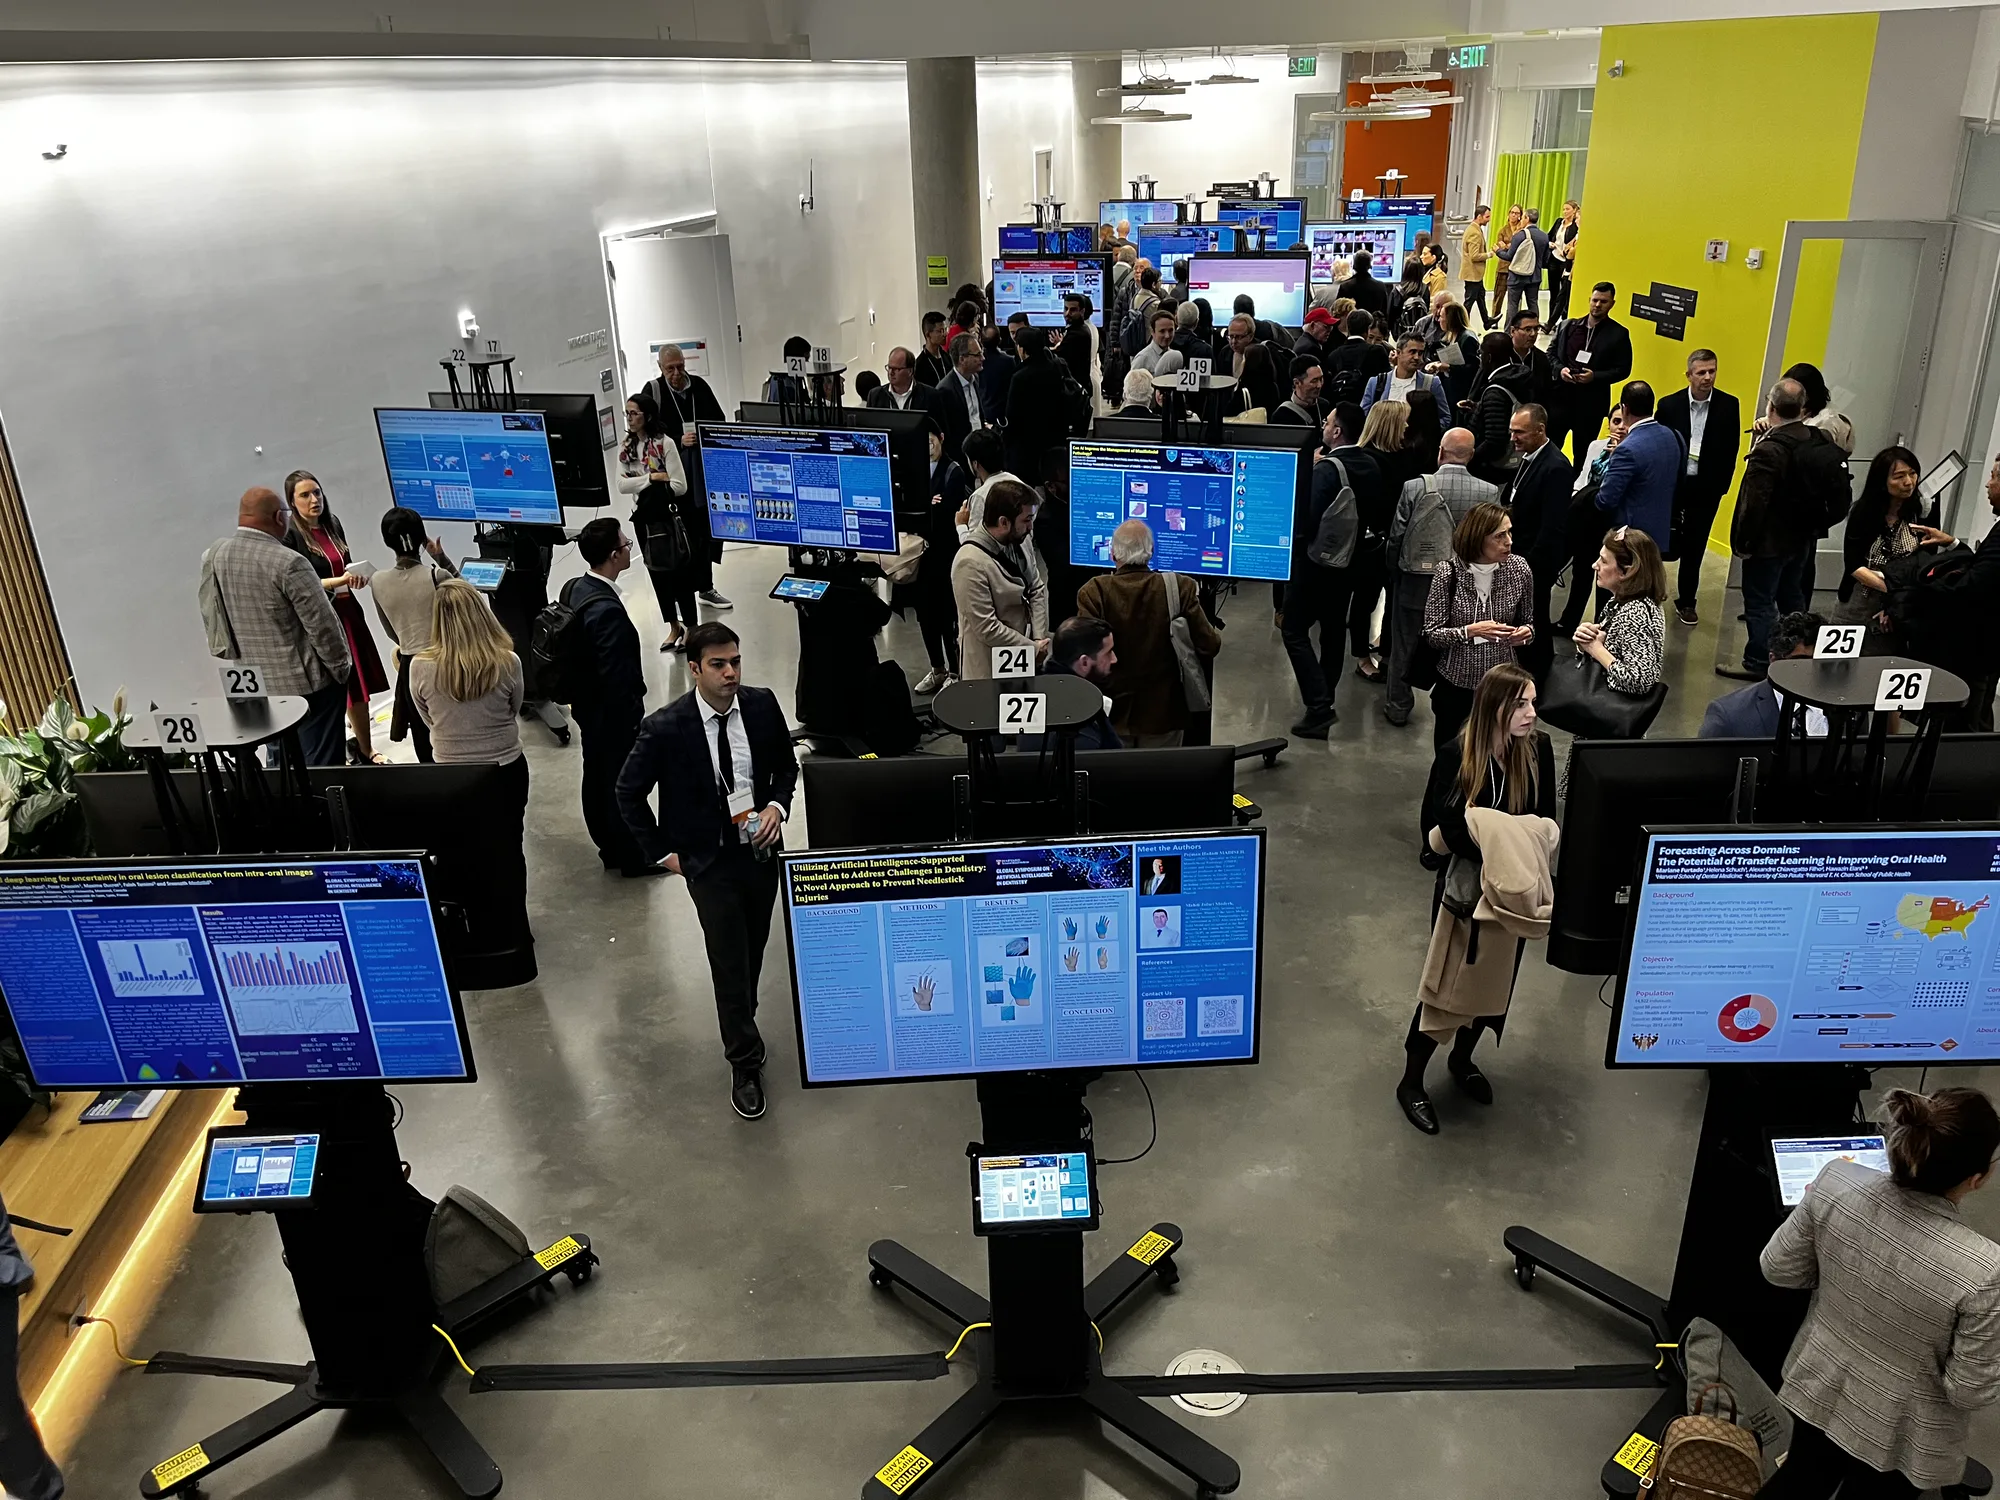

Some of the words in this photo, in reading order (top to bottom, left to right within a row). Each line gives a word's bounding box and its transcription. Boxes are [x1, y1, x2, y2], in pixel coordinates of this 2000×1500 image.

[1298, 57, 1315, 72] EXIT
[1460, 45, 1486, 68] EXIT
[452, 350, 465, 361] 22
[487, 341, 497, 352] 17
[816, 349, 827, 361] 18
[791, 359, 802, 371] 21
[1194, 360, 1207, 373] 19
[1181, 372, 1196, 385] 20
[1822, 629, 1856, 654] 25
[999, 649, 1028, 673] 24
[227, 669, 259, 693] 23
[1885, 673, 1921, 700] 26
[1006, 698, 1038, 723] 27
[163, 717, 197, 743] 28
[1660, 846, 1717, 857] Forecasting
[1718, 846, 1751, 854] Across
[1752, 845, 1800, 854] Domains:
[1678, 856, 1723, 865] Potential
[1725, 856, 1735, 865] of
[1736, 856, 1779, 865] Transfer
[1780, 856, 1824, 866] Learning
[1826, 856, 1836, 864] in
[1838, 855, 1889, 866] Improving
[1890, 855, 1912, 864] Oral
[1913, 854, 1947, 864] Health
[792, 862, 829, 872] Utilizing
[830, 861, 868, 870] Artificial
[870, 855, 964, 868] Intelligence-Supported
[793, 872, 838, 882] Simulation
[851, 870, 885, 879] Address
[886, 868, 932, 877] Challenges
[934, 866, 943, 874] in
[944, 864, 987, 874] Dentistry:
[4, 876, 23, 884] deep
[25, 876, 58, 884] learning
[72, 874, 117, 883] uncertainty
[145, 872, 169, 880] lesion
[171, 870, 222, 879] classification
[224, 870, 243, 878] from
[284, 868, 314, 877] images
[803, 883, 827, 891] Novel
[829, 881, 871, 891] Approach
[872, 880, 881, 888] to
[883, 878, 915, 887] Prevent
[916, 876, 964, 885] Needlestick
[795, 894, 829, 903] Injuries
[807, 908, 859, 917] BACKGROUND
[1063, 1008, 1113, 1016] CONCLUSION
[544, 1246, 578, 1268] CAUTION
[1142, 1240, 1169, 1264] CAUTION
[1620, 1437, 1640, 1459] HAZARD
[1626, 1441, 1649, 1466] TRIPPING
[157, 1447, 199, 1473] CAUTION
[162, 1456, 202, 1479] TRIPPING
[883, 1451, 910, 1476] HAZARD
[886, 1454, 917, 1482] TRIPPING
[167, 1461, 202, 1483] HAZARD
[893, 1459, 927, 1490] CAUTION
